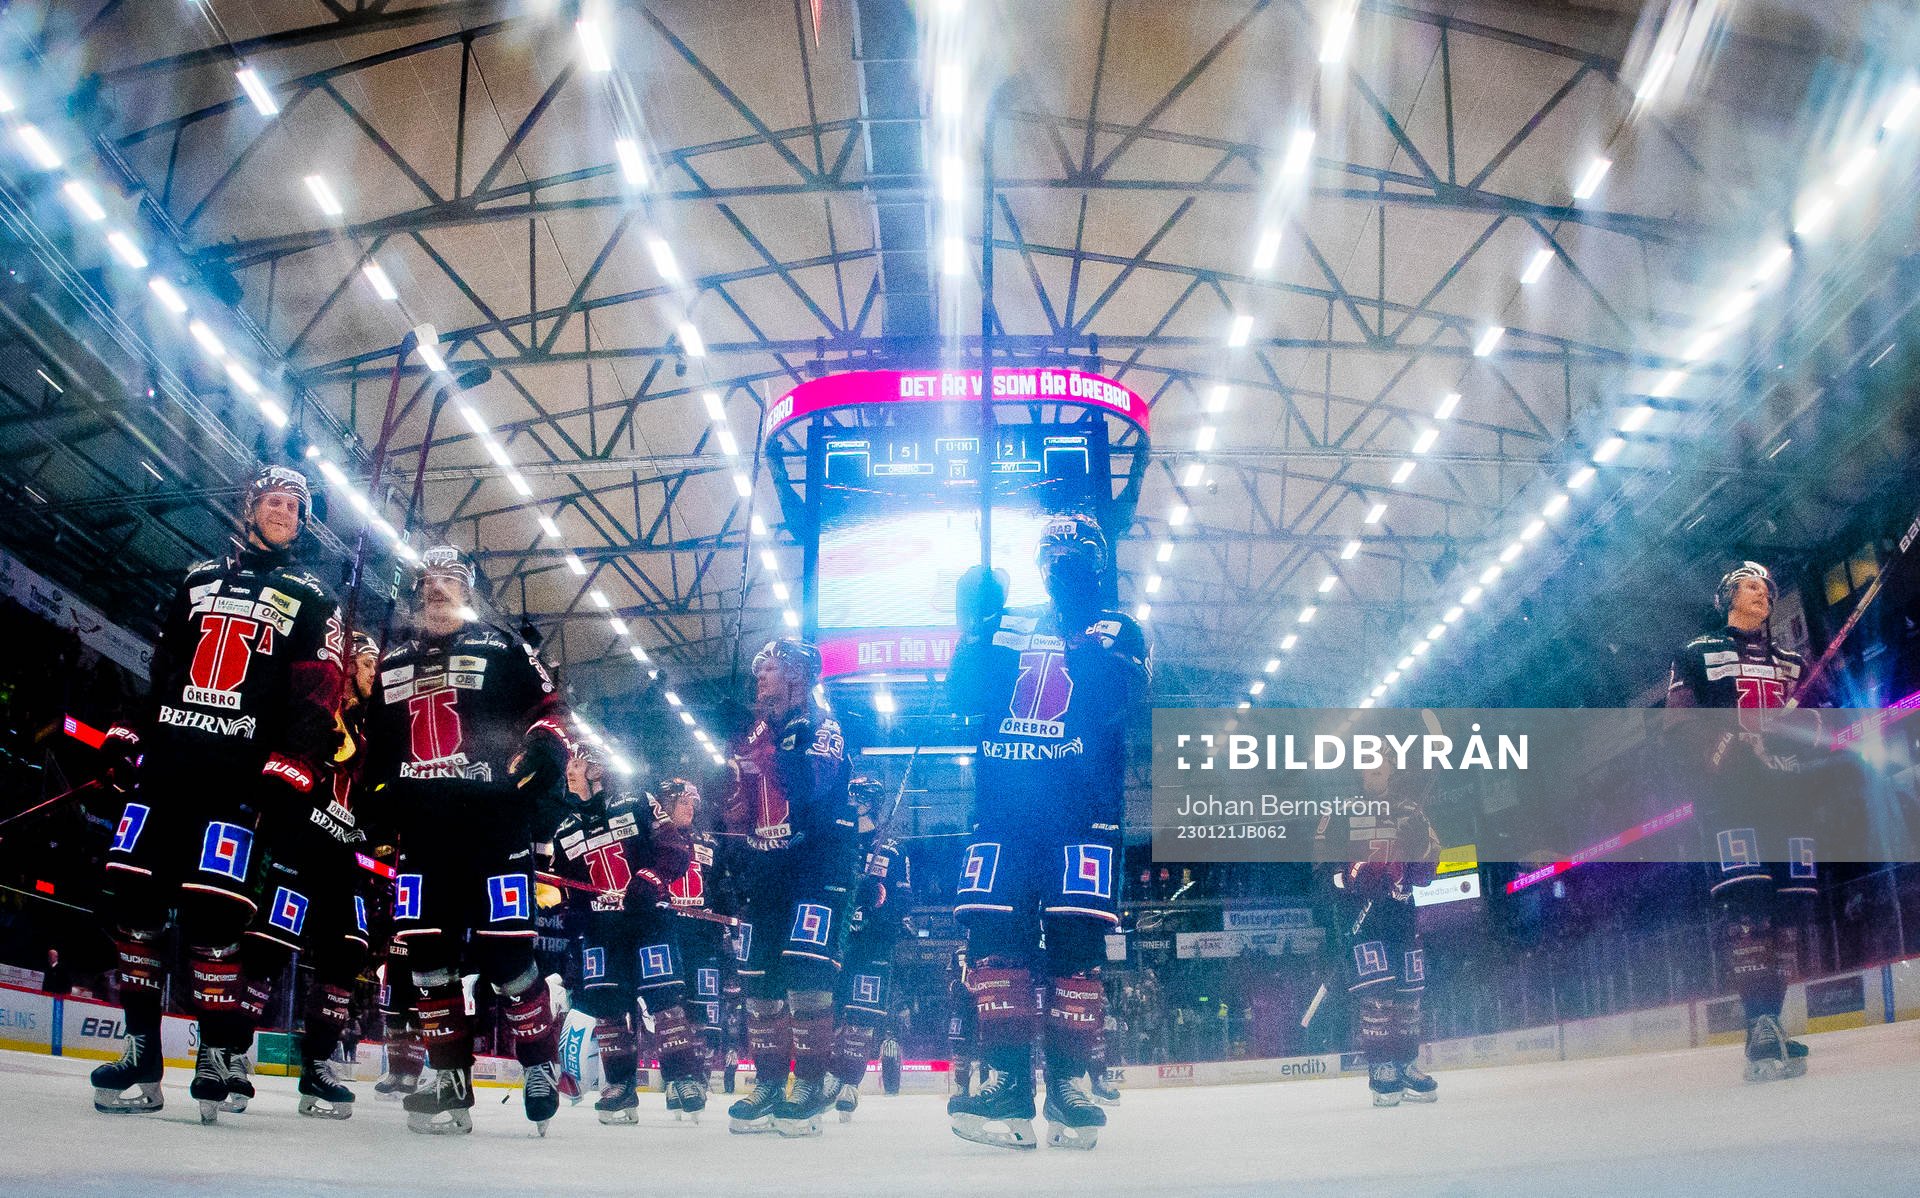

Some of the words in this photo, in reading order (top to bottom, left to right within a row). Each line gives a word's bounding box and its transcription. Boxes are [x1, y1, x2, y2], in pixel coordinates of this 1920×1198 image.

[901, 376, 937, 397] DET
[970, 375, 983, 396] V
[993, 375, 1036, 395] SOM
[1041, 371, 1067, 395] ÄR
[1069, 372, 1131, 411] ÖREBRO
[901, 446, 911, 457] 5
[1004, 444, 1015, 456] 2
[261, 606, 288, 628] OBK
[256, 625, 274, 655] A
[858, 640, 896, 665] DET
[187, 687, 236, 707] ÖREBRO
[159, 705, 233, 736] BEHRN
[1003, 720, 1060, 736] ÖREBRO
[106, 727, 140, 745] UER
[982, 740, 1058, 761] BEHRN
[263, 760, 310, 787] AUER
[1419, 886, 1459, 898] Swedbank
[1734, 963, 1766, 974] STILL
[121, 973, 160, 990] STILL
[194, 989, 236, 1003] STILL
[976, 1001, 1015, 1012] TILL
[1050, 1008, 1096, 1022] STILL
[1281, 1059, 1323, 1076] endit
